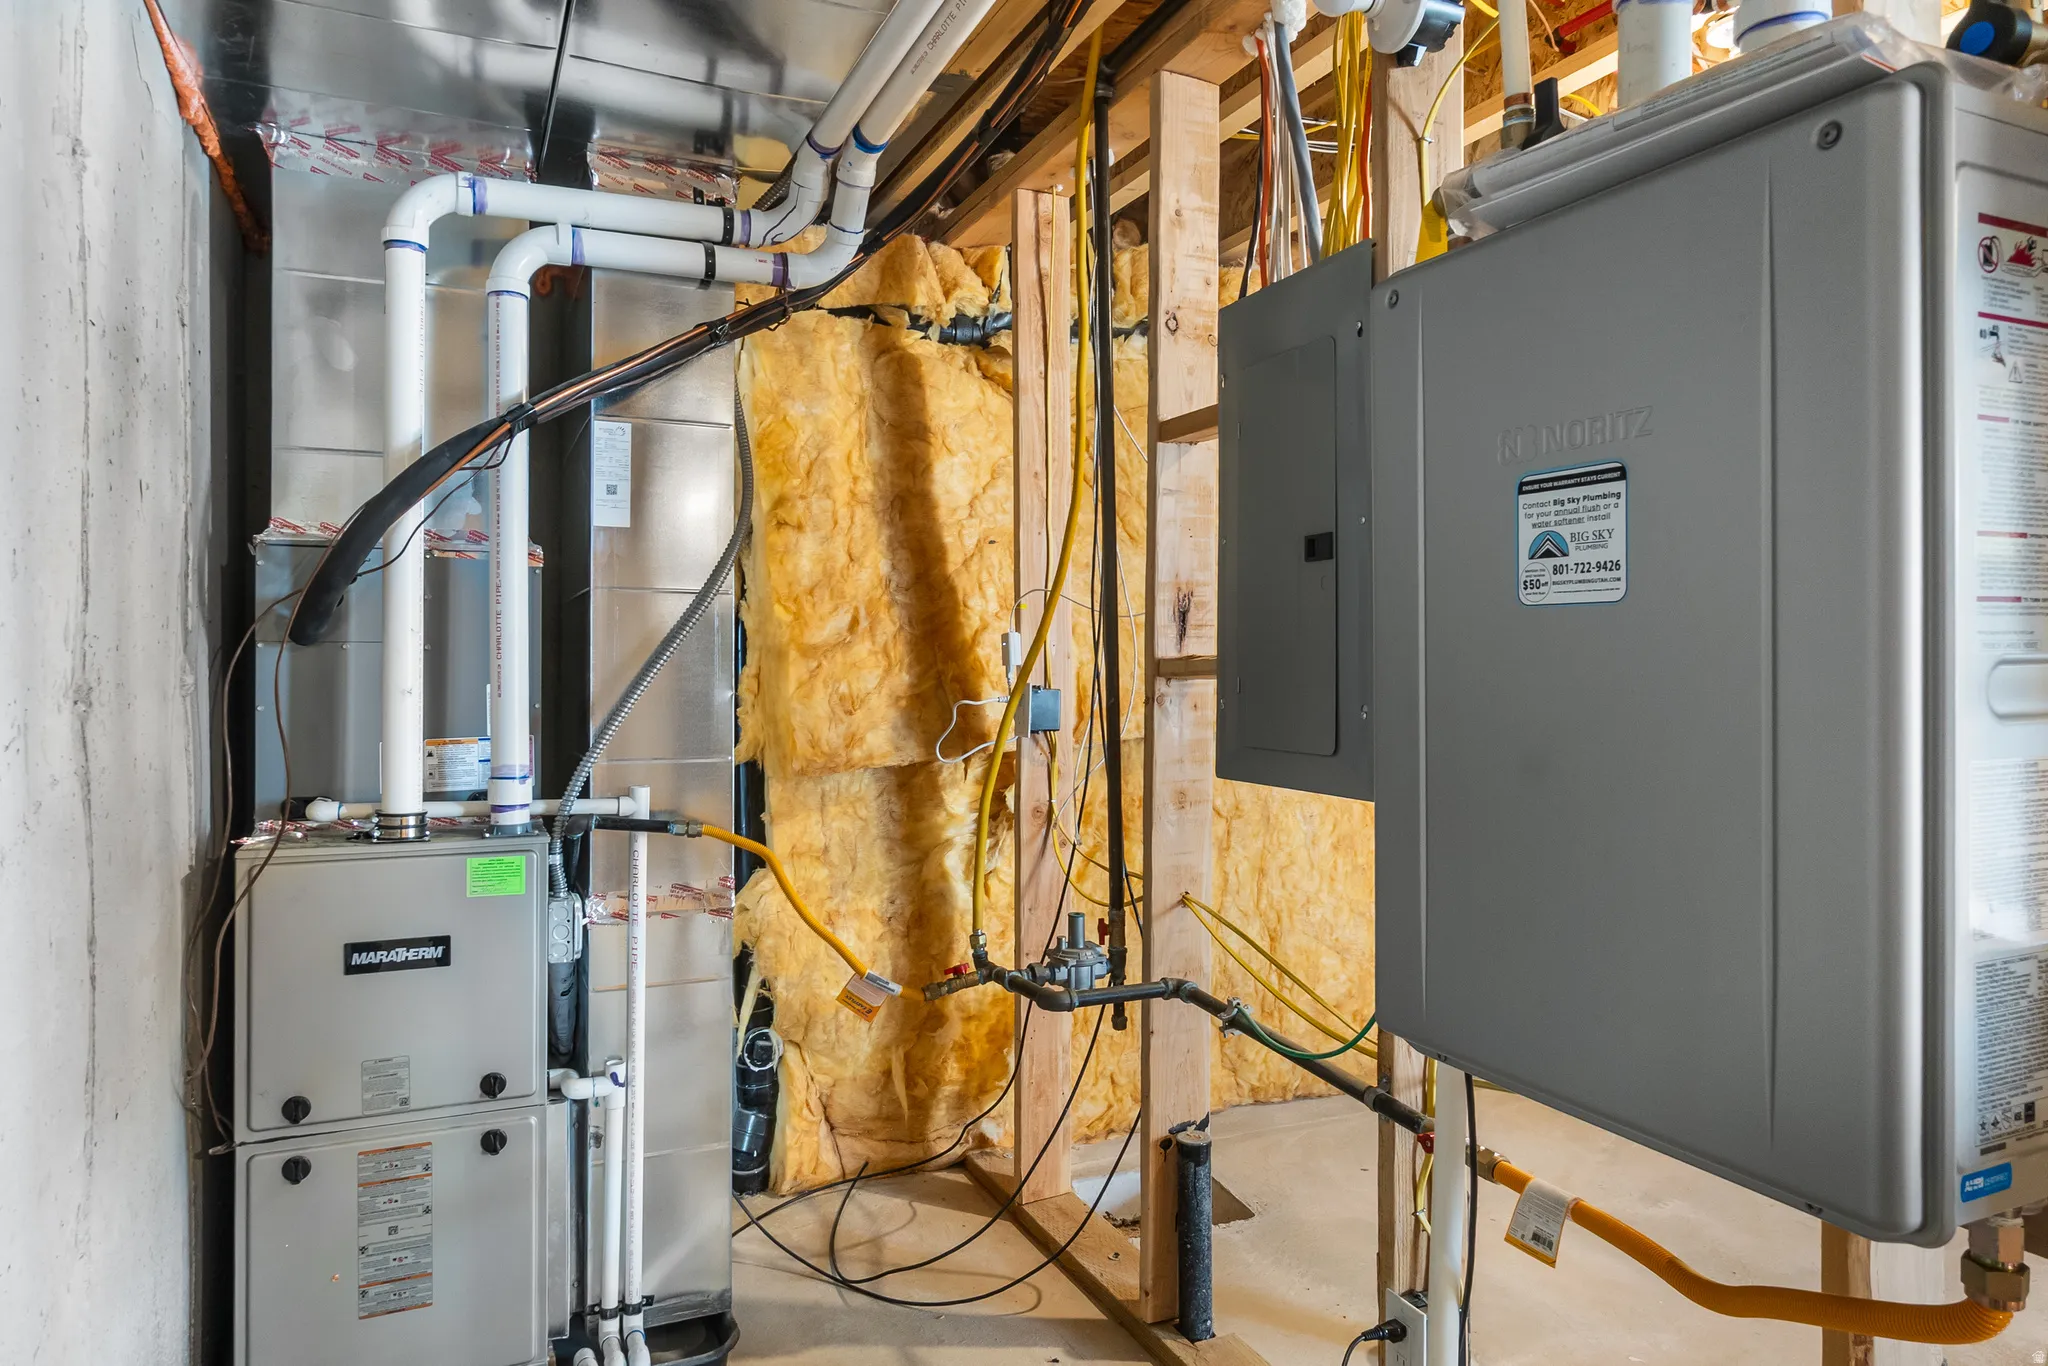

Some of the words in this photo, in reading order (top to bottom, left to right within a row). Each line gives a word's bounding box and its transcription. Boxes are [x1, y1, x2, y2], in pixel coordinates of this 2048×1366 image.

[927, 11, 957, 51] CHARLOTTE
[1542, 406, 1654, 456] NORITZ
[1522, 483, 1540, 491] ENSURE
[1540, 481, 1553, 489] YOUR
[1553, 477, 1580, 487] WARRANTY
[1581, 475, 1597, 483] STAYS
[1522, 500, 1551, 510] Contact
[1552, 498, 1565, 507] Big
[1567, 496, 1581, 505] Sky
[1582, 490, 1622, 503] Plumbing
[1524, 512, 1534, 520] for
[1536, 510, 1552, 519] your
[1554, 506, 1580, 516] annual
[1582, 503, 1601, 512] flush
[1532, 520, 1552, 528] water
[1553, 516, 1585, 526] softener
[1586, 512, 1611, 522] install
[1570, 531, 1590, 543] BIG
[1592, 528, 1615, 540] SKY
[1575, 543, 1609, 551] PLUMBING
[1552, 559, 1621, 576] 801-722-9426
[1522, 578, 1541, 591] $50
[631, 850, 639, 928] CHARLOTTE
[350, 945, 444, 966] MARATHERM
